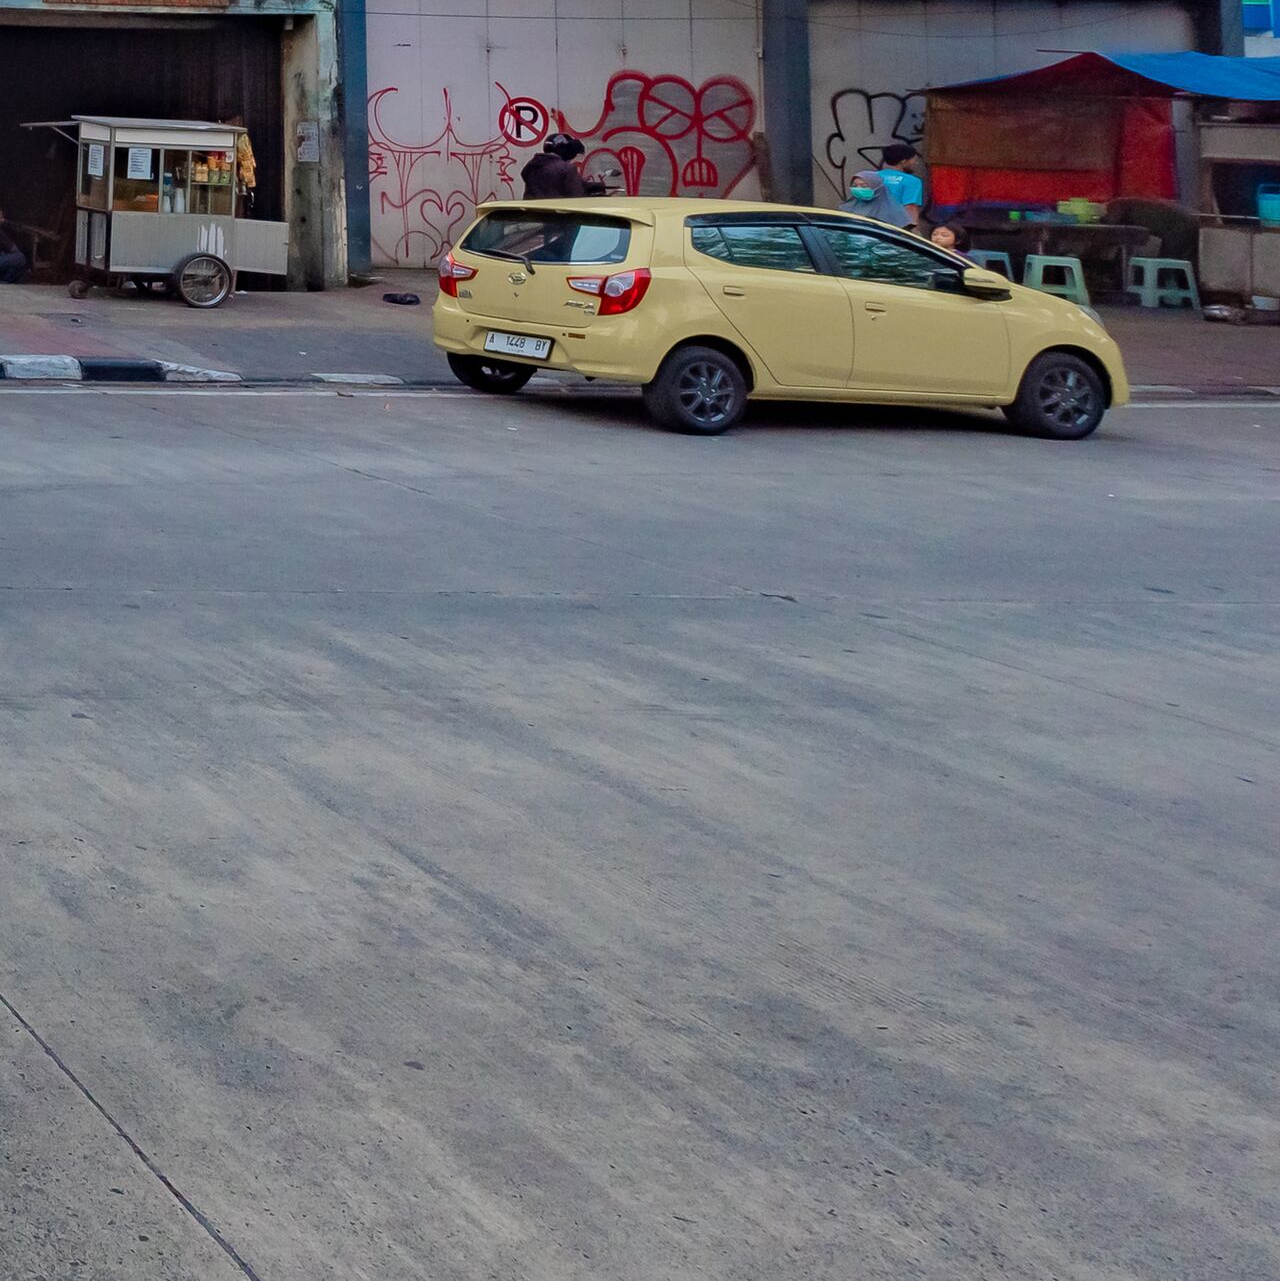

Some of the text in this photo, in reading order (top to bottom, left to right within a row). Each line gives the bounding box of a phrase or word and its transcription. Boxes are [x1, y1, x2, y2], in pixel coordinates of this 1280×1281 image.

[489, 333, 547, 352] A 1448 BY
